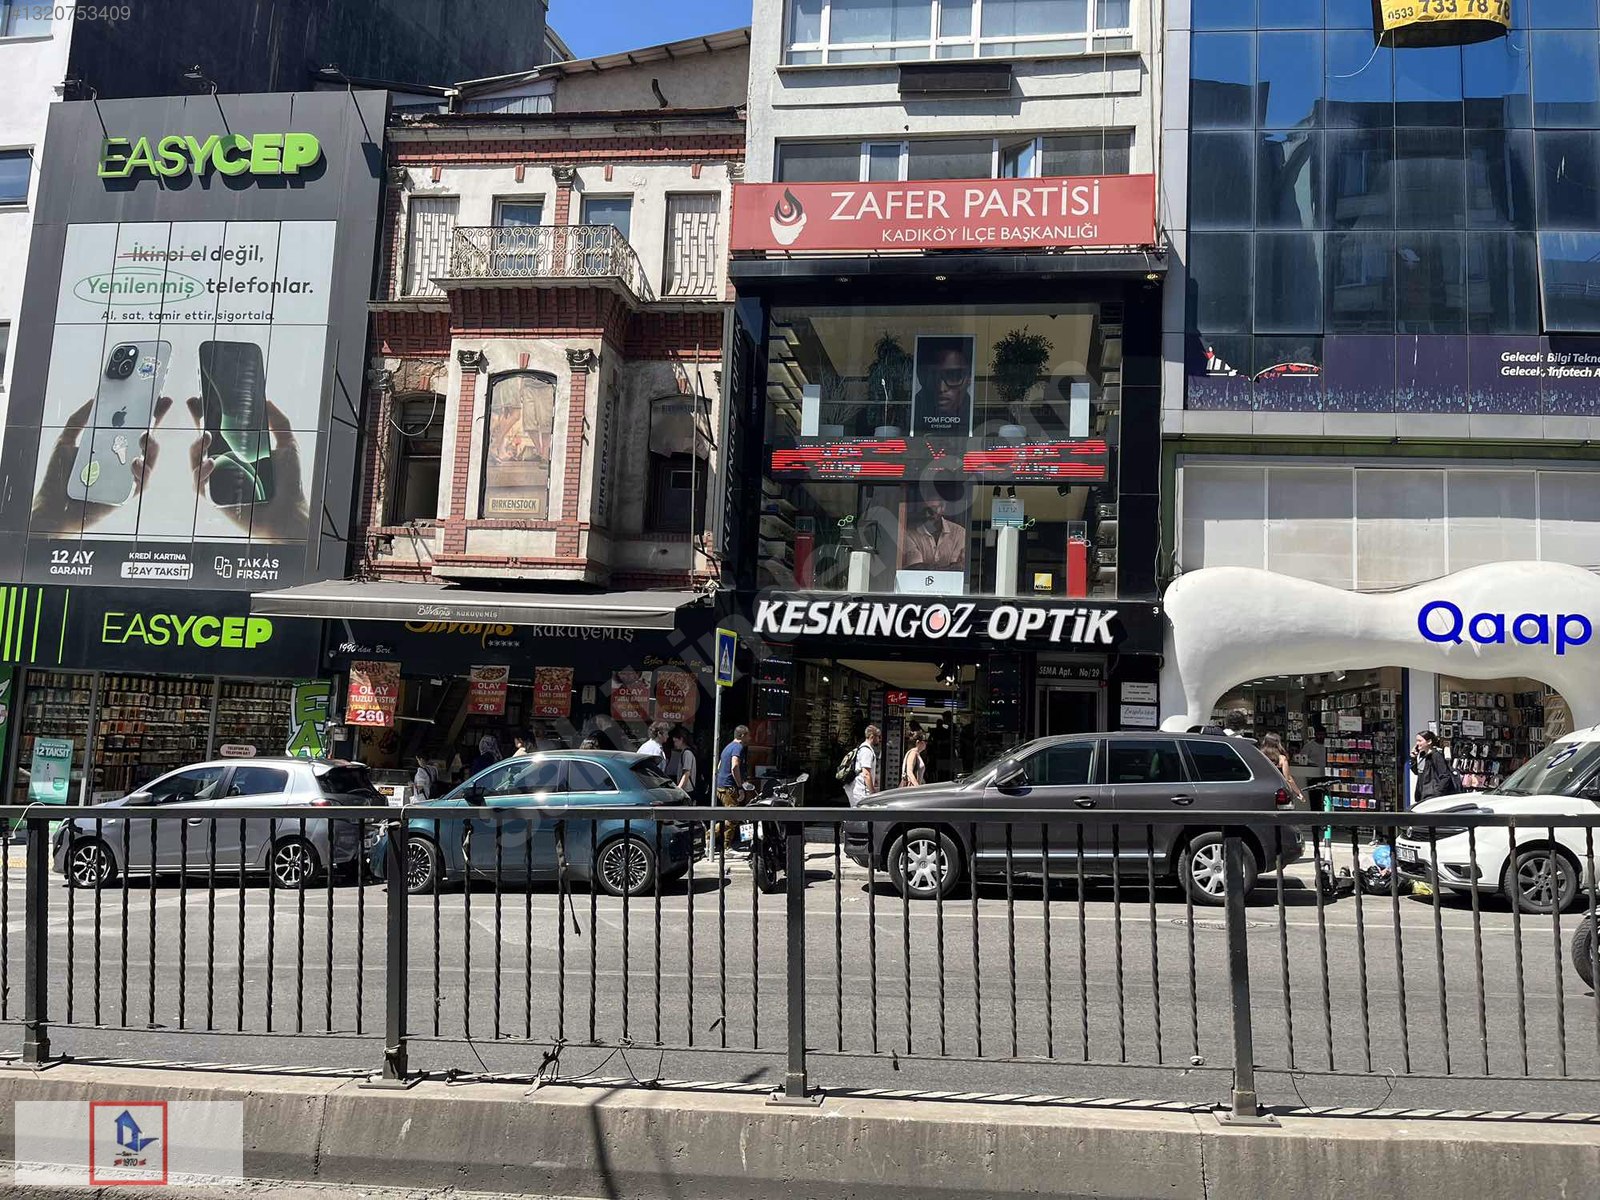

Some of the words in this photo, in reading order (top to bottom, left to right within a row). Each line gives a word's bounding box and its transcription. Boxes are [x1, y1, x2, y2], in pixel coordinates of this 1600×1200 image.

[97, 132, 320, 178] EASYCEP
[829, 189, 950, 222] ZAFER
[964, 179, 1101, 219] PARTİSİ
[881, 226, 955, 243] KADIKÖY
[961, 226, 996, 243] İLÇE
[1000, 223, 1098, 241] BAŞKANLIĞI
[132, 242, 184, 262] İkinci
[190, 246, 206, 262] el
[210, 245, 264, 265] değil,
[87, 277, 194, 299] Yenilenmiş
[206, 277, 314, 295] telefonlar.
[1547, 352, 1571, 364] Bilgi
[940, 416, 961, 424] FORD
[491, 498, 537, 511] BIRKENSTOCK
[51, 550, 69, 564] 12
[71, 550, 95, 565] AY
[129, 551, 151, 560] KREDİ
[153, 552, 187, 561] KARTINA
[237, 558, 280, 569] TAKAS
[50, 564, 93, 576] GARANTİ
[154, 565, 189, 577] TAKSİT
[236, 569, 279, 580] FIRSATI
[102, 611, 274, 649] EASYCEP
[1417, 600, 1593, 656] Qaap
[1039, 666, 1057, 676] SEMA
[1058, 667, 1073, 678] Apt.
[1079, 668, 1100, 678] No/29
[360, 686, 389, 695] OLAY
[664, 689, 689, 697] OLAY
[35, 747, 45, 756] 12
